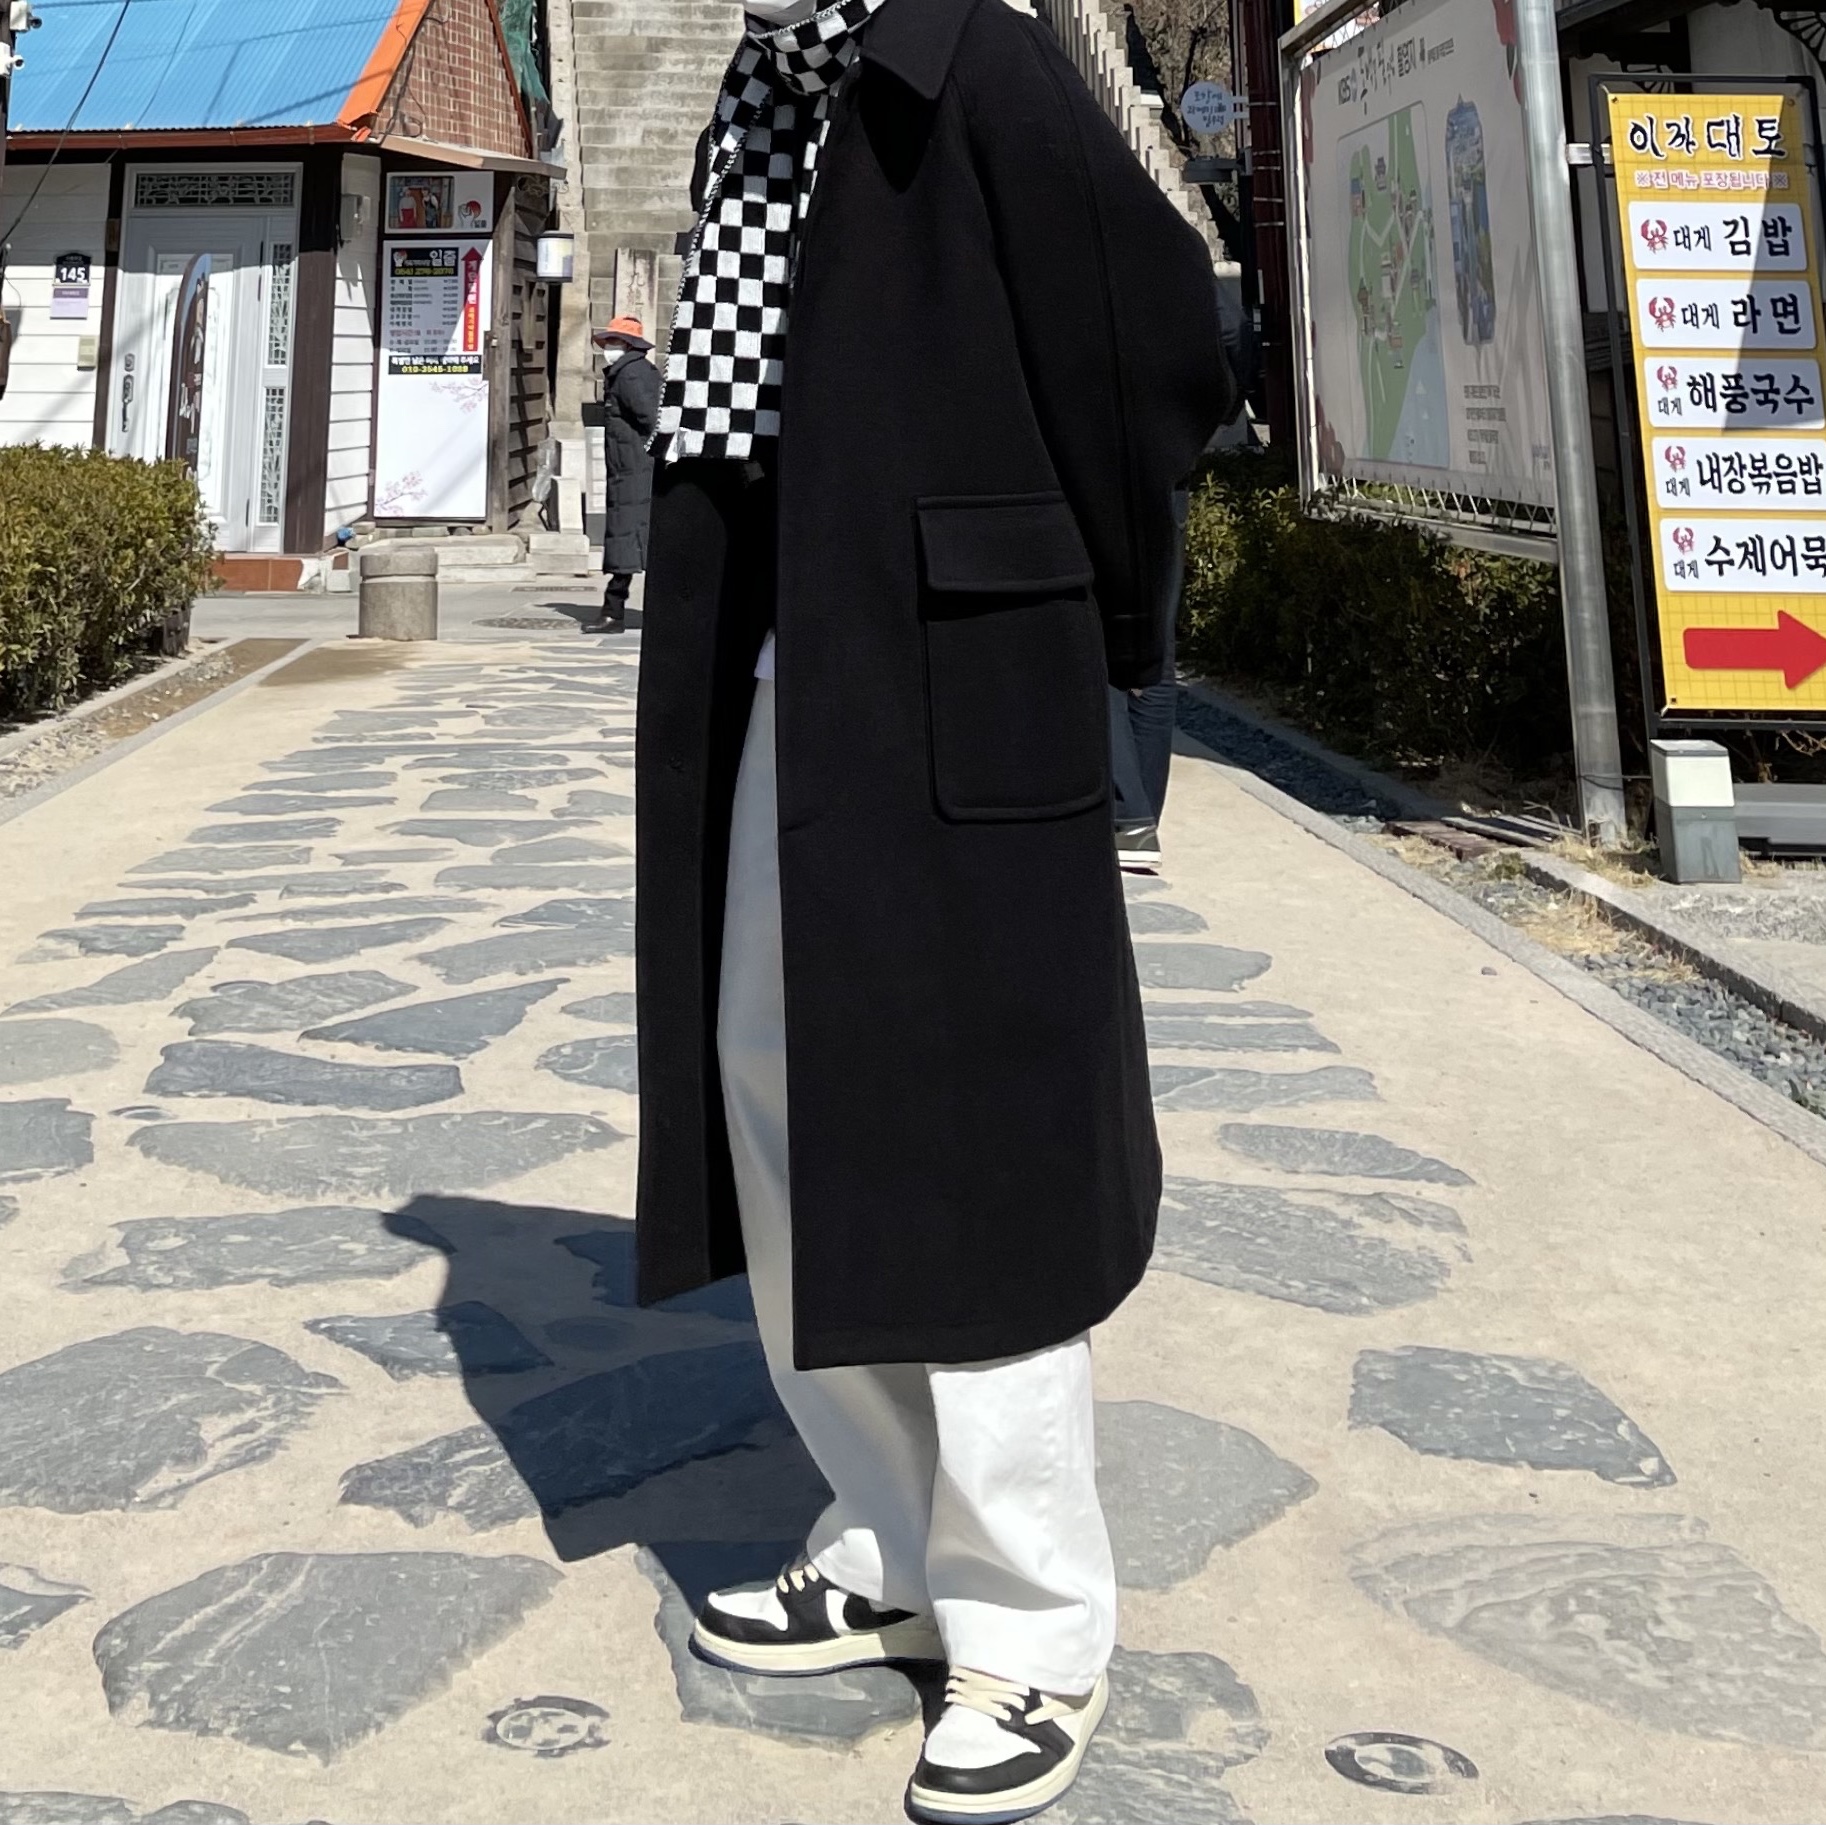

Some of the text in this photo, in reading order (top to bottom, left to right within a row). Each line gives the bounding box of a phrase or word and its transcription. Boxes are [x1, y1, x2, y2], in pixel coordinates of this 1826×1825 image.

[1703, 172, 1768, 189] 포장됩니다
[1673, 225, 1712, 251] 대게
[60, 267, 86, 281] 145
[1681, 302, 1720, 329] 대게
[1658, 372, 1815, 416] 대게 해풍국수
[1666, 452, 1823, 497] 대게 내장볶음밥
[1673, 534, 1826, 579] 대게 수제어묵
